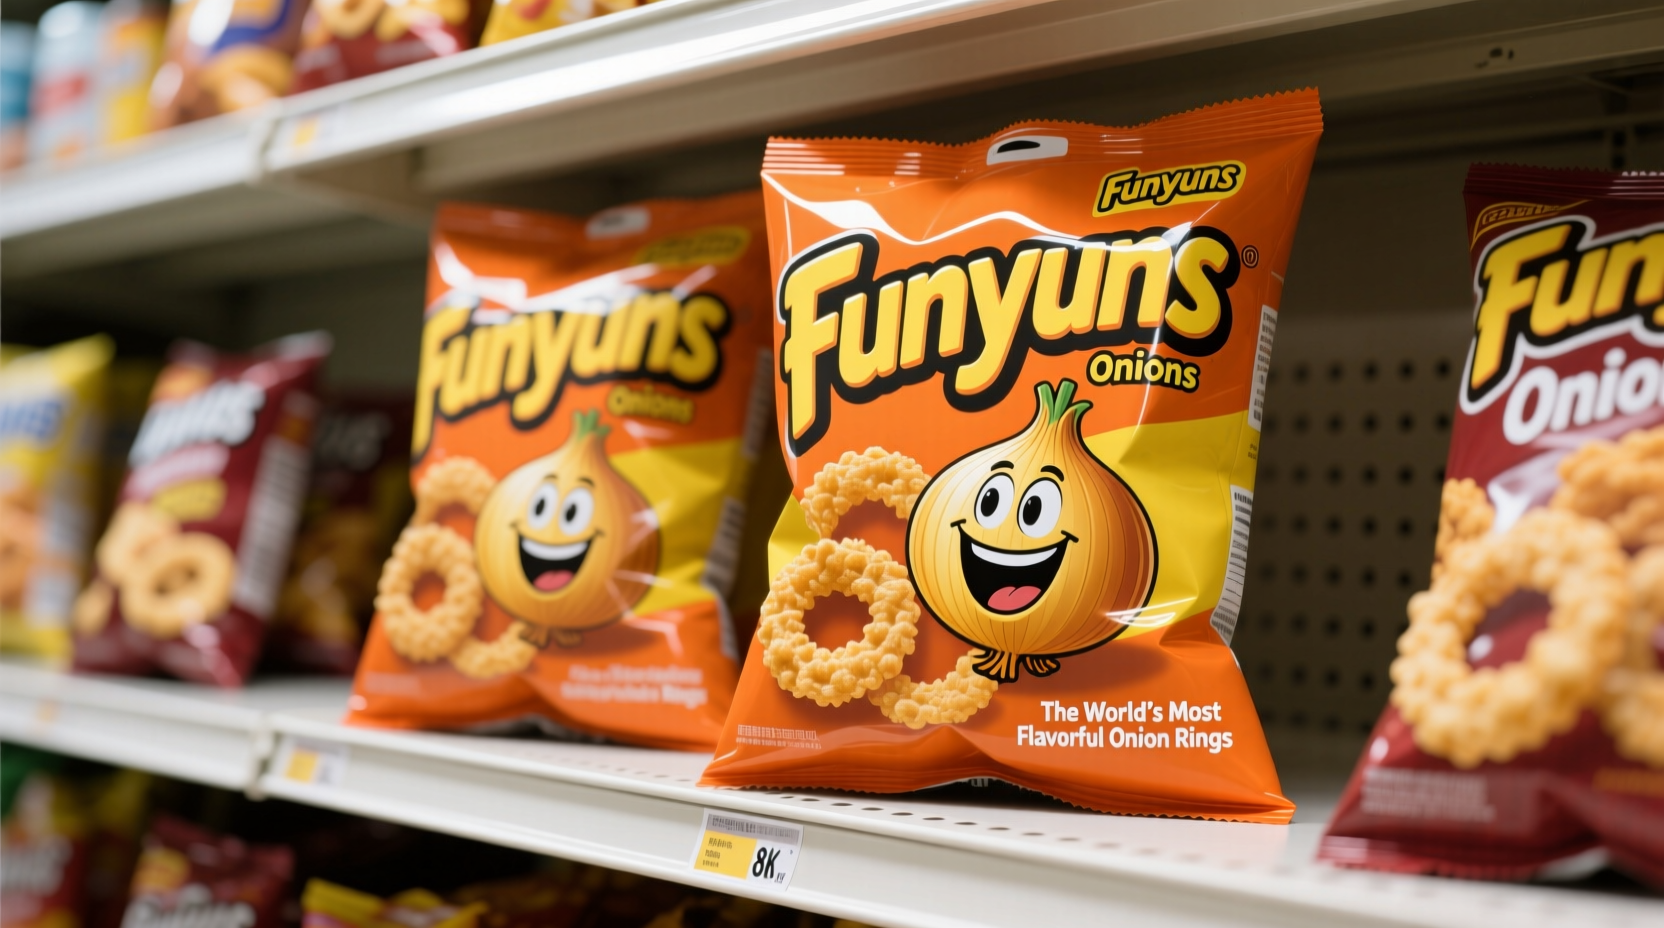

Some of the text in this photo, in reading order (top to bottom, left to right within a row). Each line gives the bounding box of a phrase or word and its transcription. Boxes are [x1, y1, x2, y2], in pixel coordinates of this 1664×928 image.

[1099, 165, 1238, 210] Funyuns
[782, 231, 1233, 447] Funyuns
[1470, 222, 1664, 393] Fun
[411, 290, 728, 456] Funyuns
[1090, 352, 1198, 391] Onions
[1503, 348, 1664, 445] Onio
[1017, 725, 1233, 754] Flavorful Onion Rings
[1041, 700, 1222, 722] The World's Most
